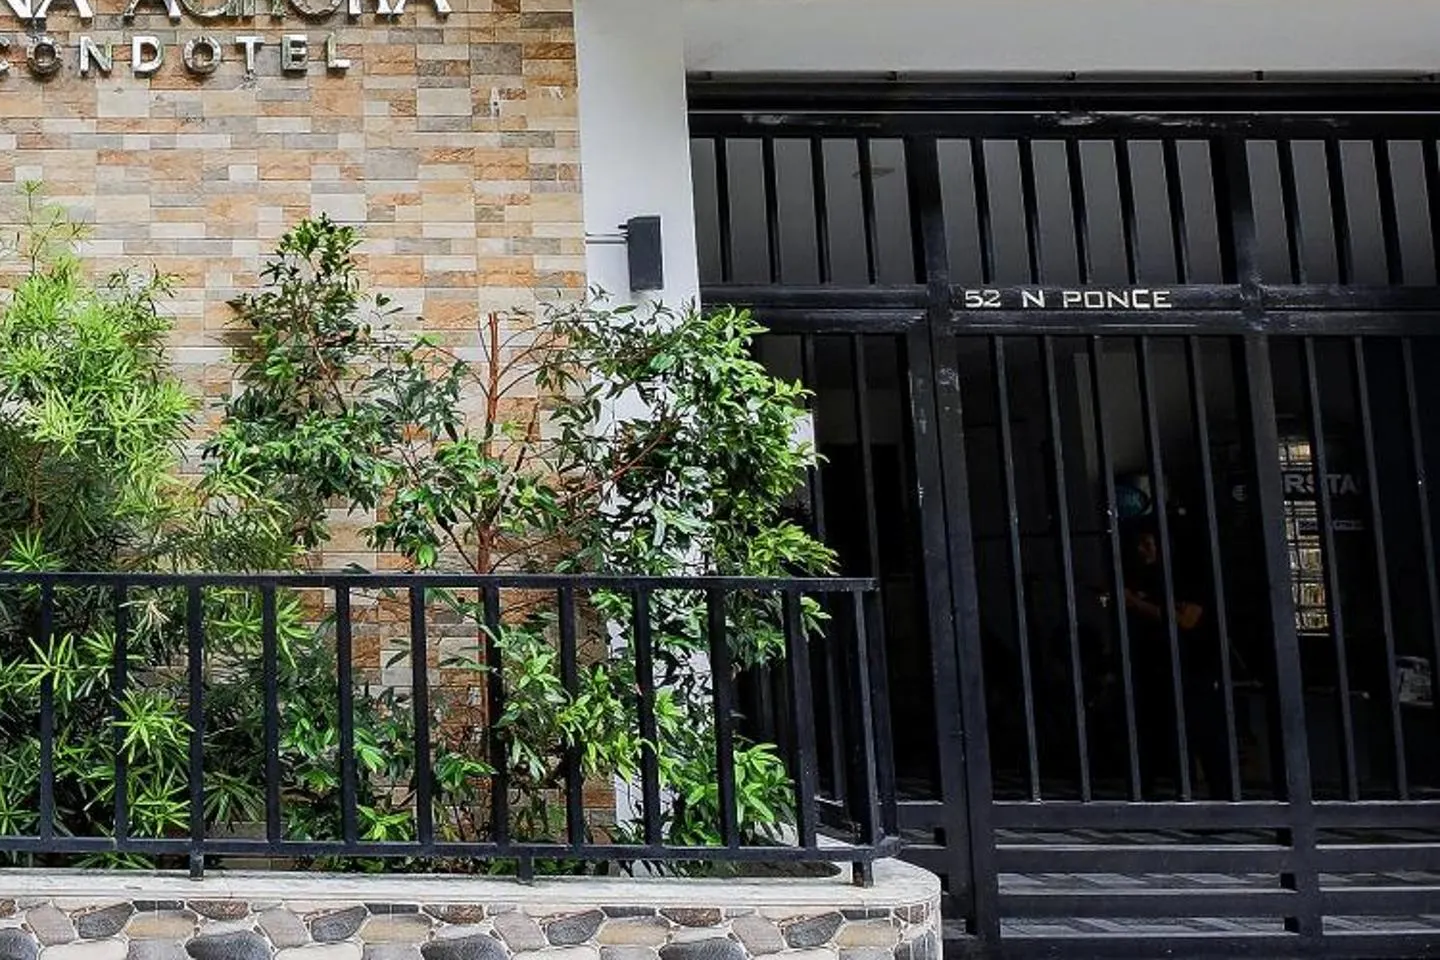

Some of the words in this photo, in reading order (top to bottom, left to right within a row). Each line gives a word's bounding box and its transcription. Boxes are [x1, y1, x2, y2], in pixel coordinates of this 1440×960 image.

[965, 289, 1002, 309] 52
[1021, 290, 1046, 309] N
[1063, 289, 1173, 309] PONCE
